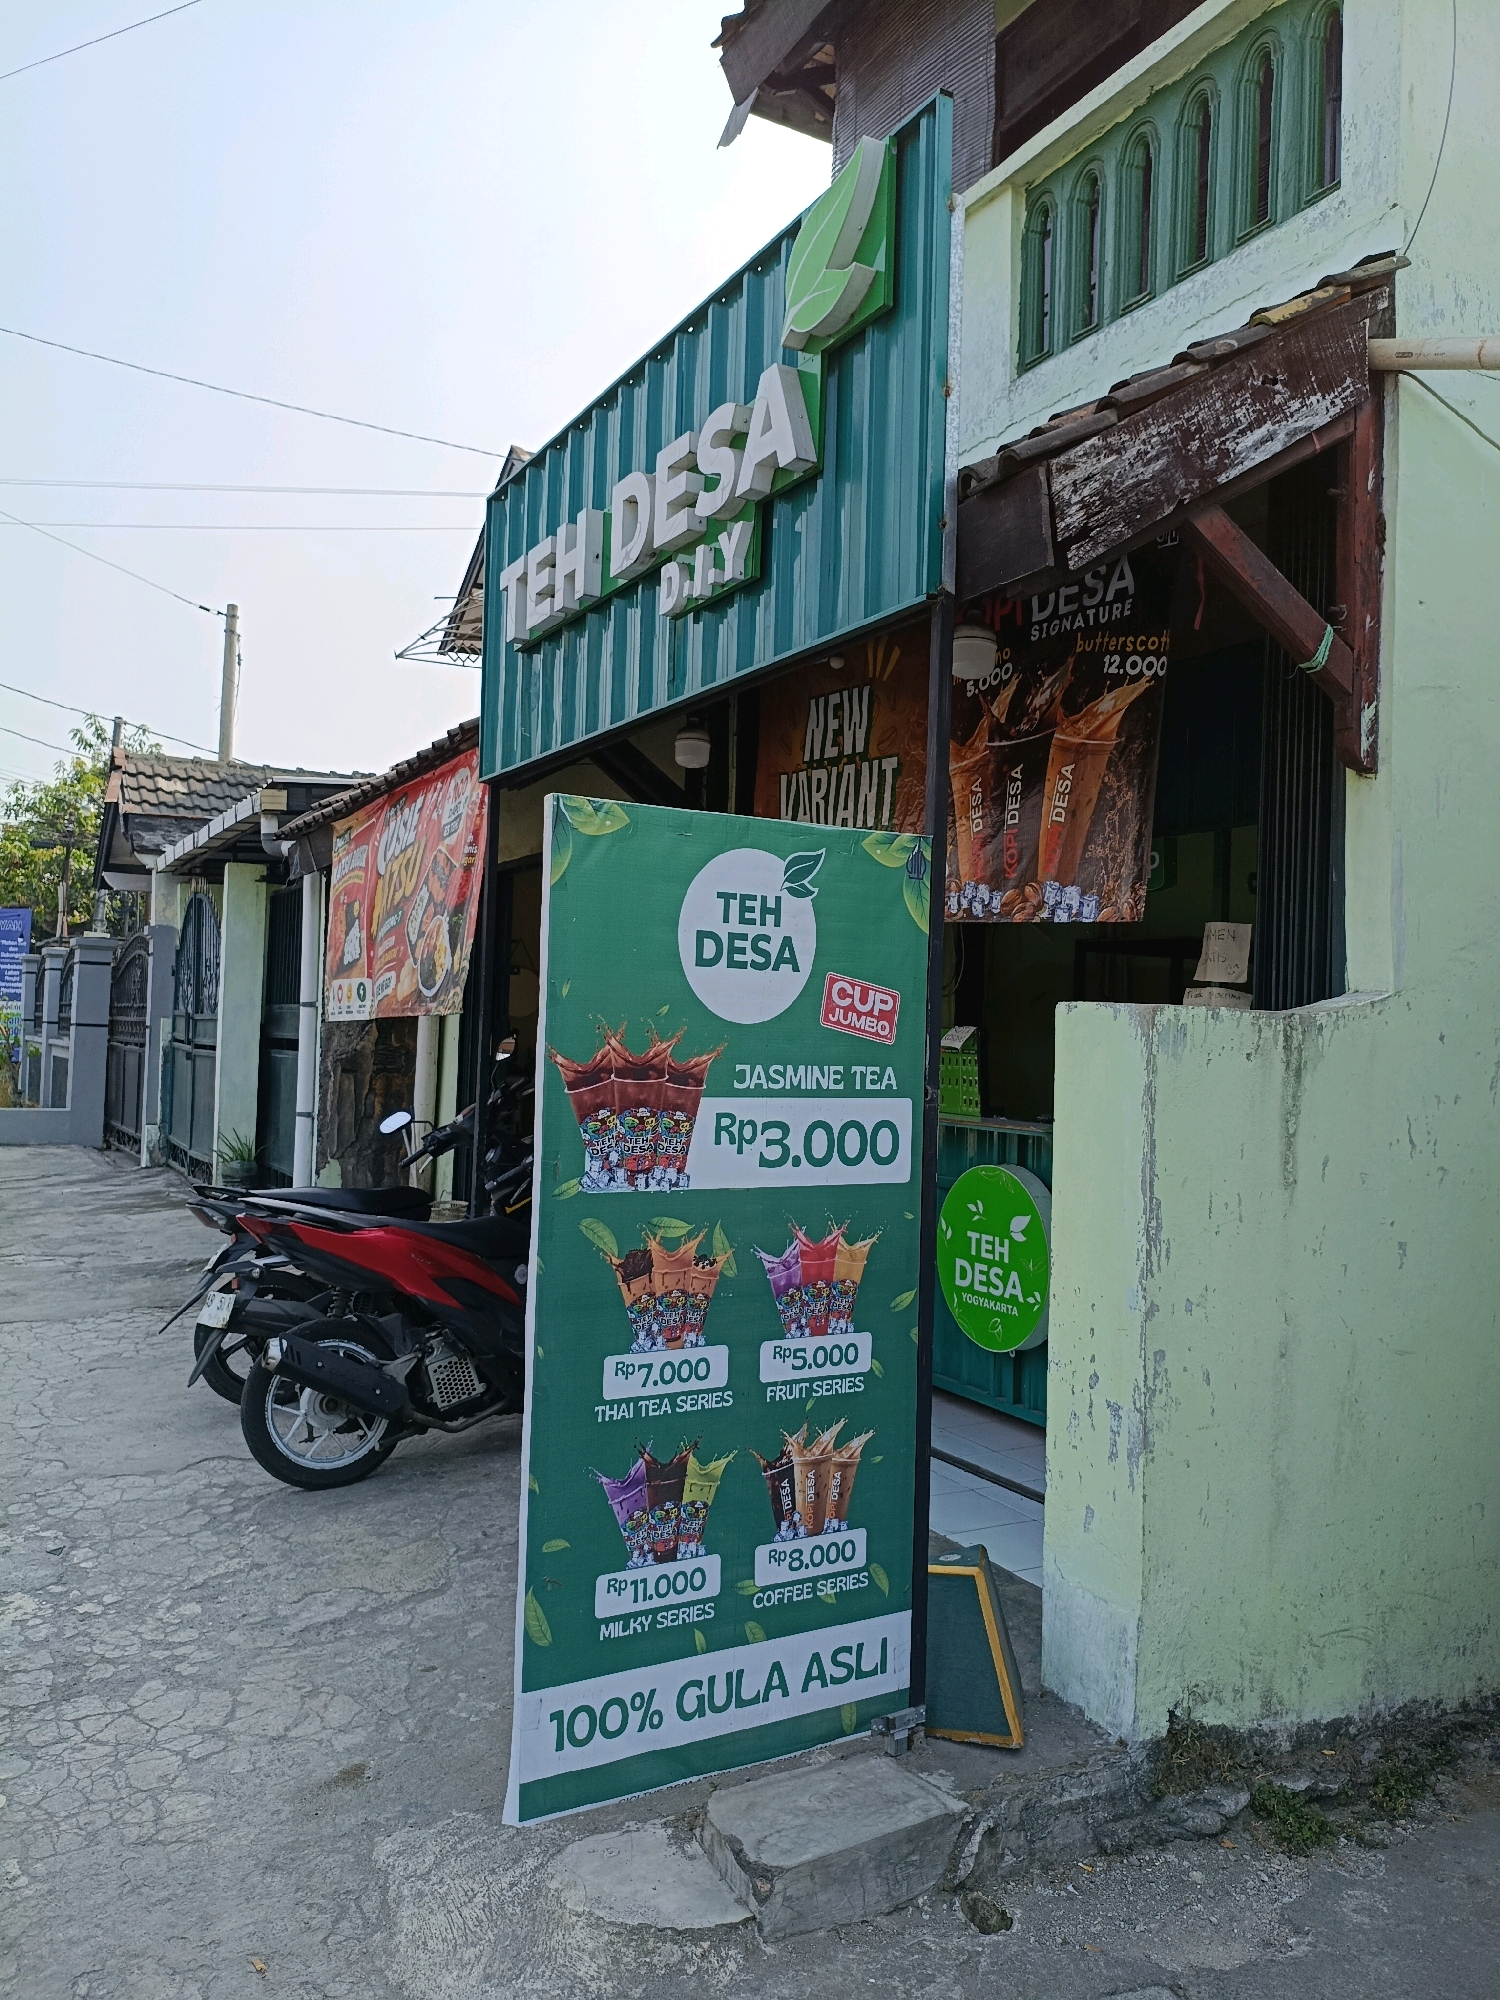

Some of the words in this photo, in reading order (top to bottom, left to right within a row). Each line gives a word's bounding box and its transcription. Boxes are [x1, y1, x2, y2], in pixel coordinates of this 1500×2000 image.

[501, 508, 603, 643] TEH
[610, 363, 817, 579] DESA
[1032, 554, 1135, 622] DESA
[1031, 599, 1133, 641] SIGNATURE
[1103, 654, 1168, 677] 12.000
[804, 685, 870, 762] NEW
[780, 757, 898, 828] VARIANT
[971, 777, 983, 832] DESA
[1007, 764, 1024, 824] DESA
[1052, 763, 1076, 822] DESA
[1004, 829, 1018, 878] KOPI
[717, 892, 782, 928] TEH
[695, 930, 801, 973] DESA
[832, 981, 893, 1016] CUP
[829, 1008, 889, 1035] JUMBO
[733, 1064, 844, 1090] JASMINE
[851, 1066, 897, 1090] TEA
[623, 1143, 654, 1154] DESA
[628, 1137, 648, 1145] TEH
[657, 1143, 686, 1154] DESA
[662, 1137, 682, 1146] TEH
[967, 1231, 1010, 1264] TEH
[955, 1258, 1024, 1303] DESA
[962, 1292, 1019, 1316] YOGYAKARTA
[595, 1402, 634, 1422] THAI
[638, 1398, 671, 1417] TEA
[676, 1391, 733, 1412] SERIES
[767, 1383, 810, 1402] FRUIT
[812, 1377, 865, 1397] SERIES
[781, 1479, 793, 1509] DESA
[808, 1470, 816, 1501] DESA
[832, 1472, 842, 1500] DESA
[806, 1503, 814, 1529] KOPI
[829, 1501, 837, 1518] OPI
[753, 1584, 813, 1609] COFFEE
[816, 1572, 869, 1595] SERIES
[600, 1615, 653, 1641] MILKY
[657, 1603, 715, 1629] SERIES
[550, 1689, 664, 1752] 100%
[676, 1661, 790, 1722] GULA
[801, 1637, 888, 1693] ASLI
